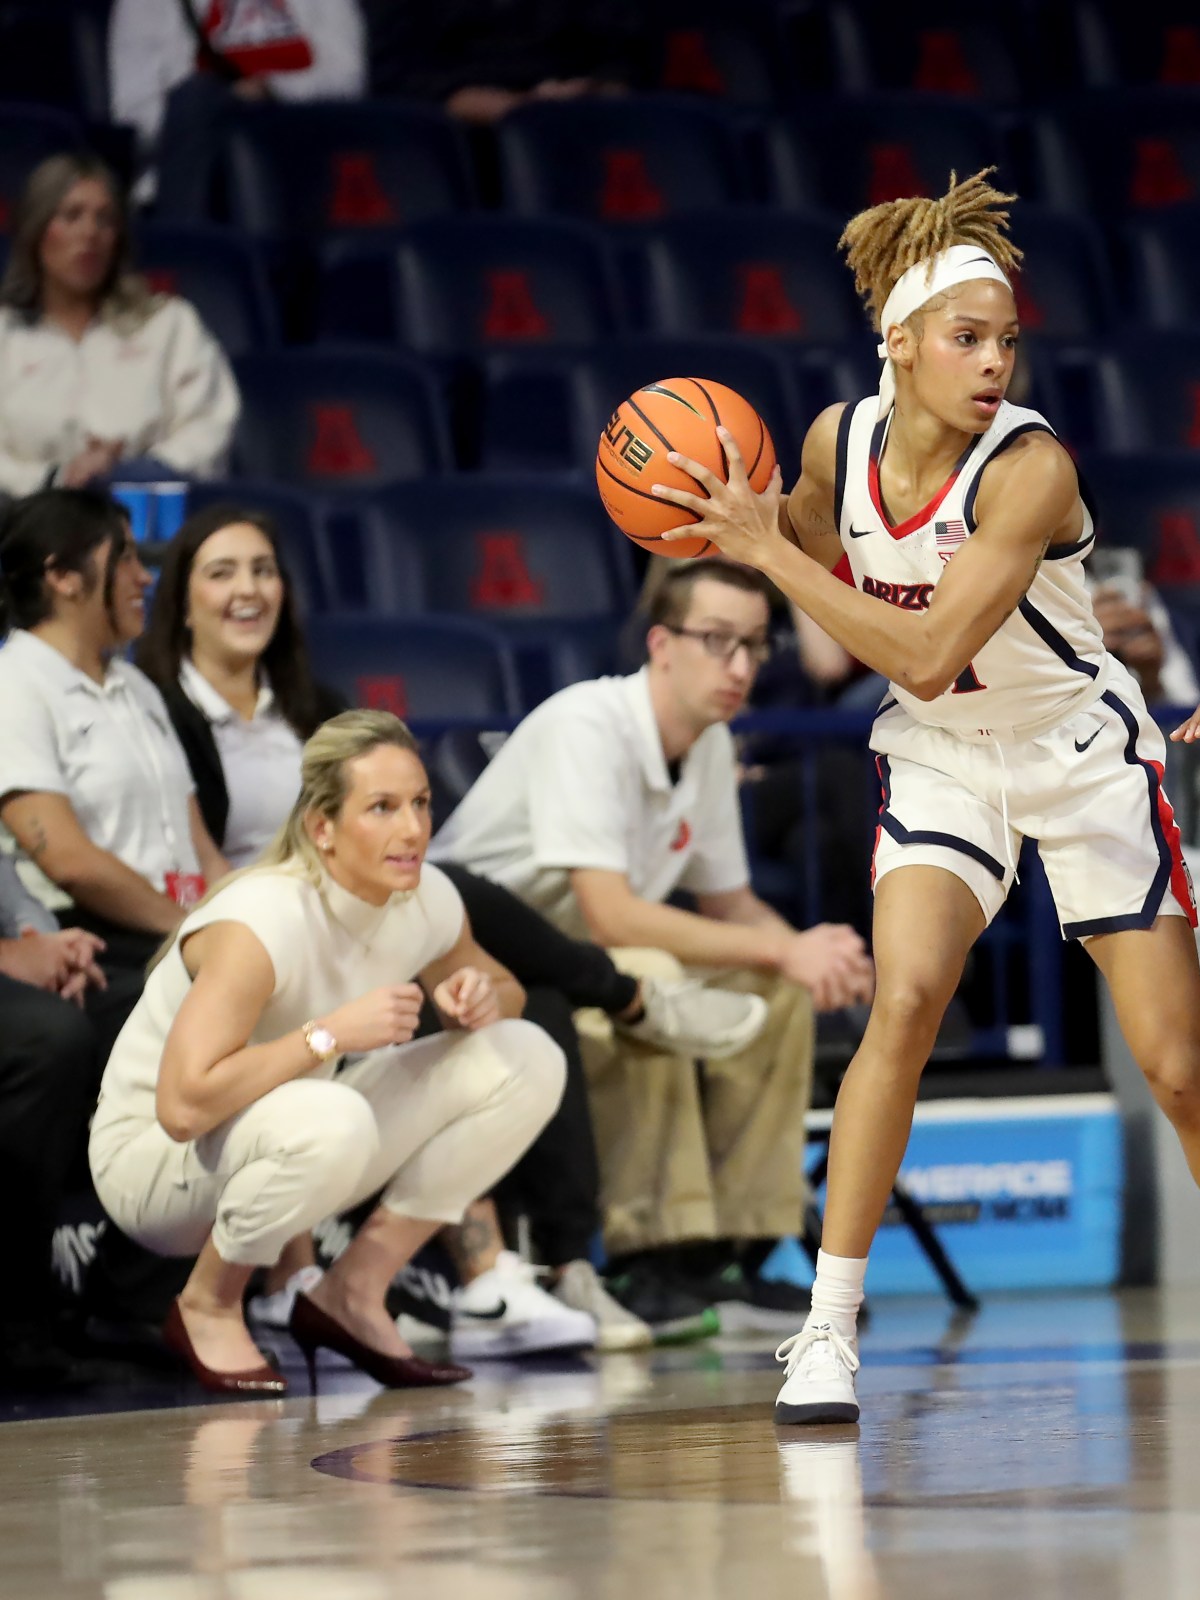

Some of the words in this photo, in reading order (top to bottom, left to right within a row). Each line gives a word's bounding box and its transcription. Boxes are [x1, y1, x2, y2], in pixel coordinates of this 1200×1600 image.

[484, 271, 546, 338] A
[738, 267, 800, 334] A
[309, 406, 374, 475] A
[473, 533, 542, 606] A
